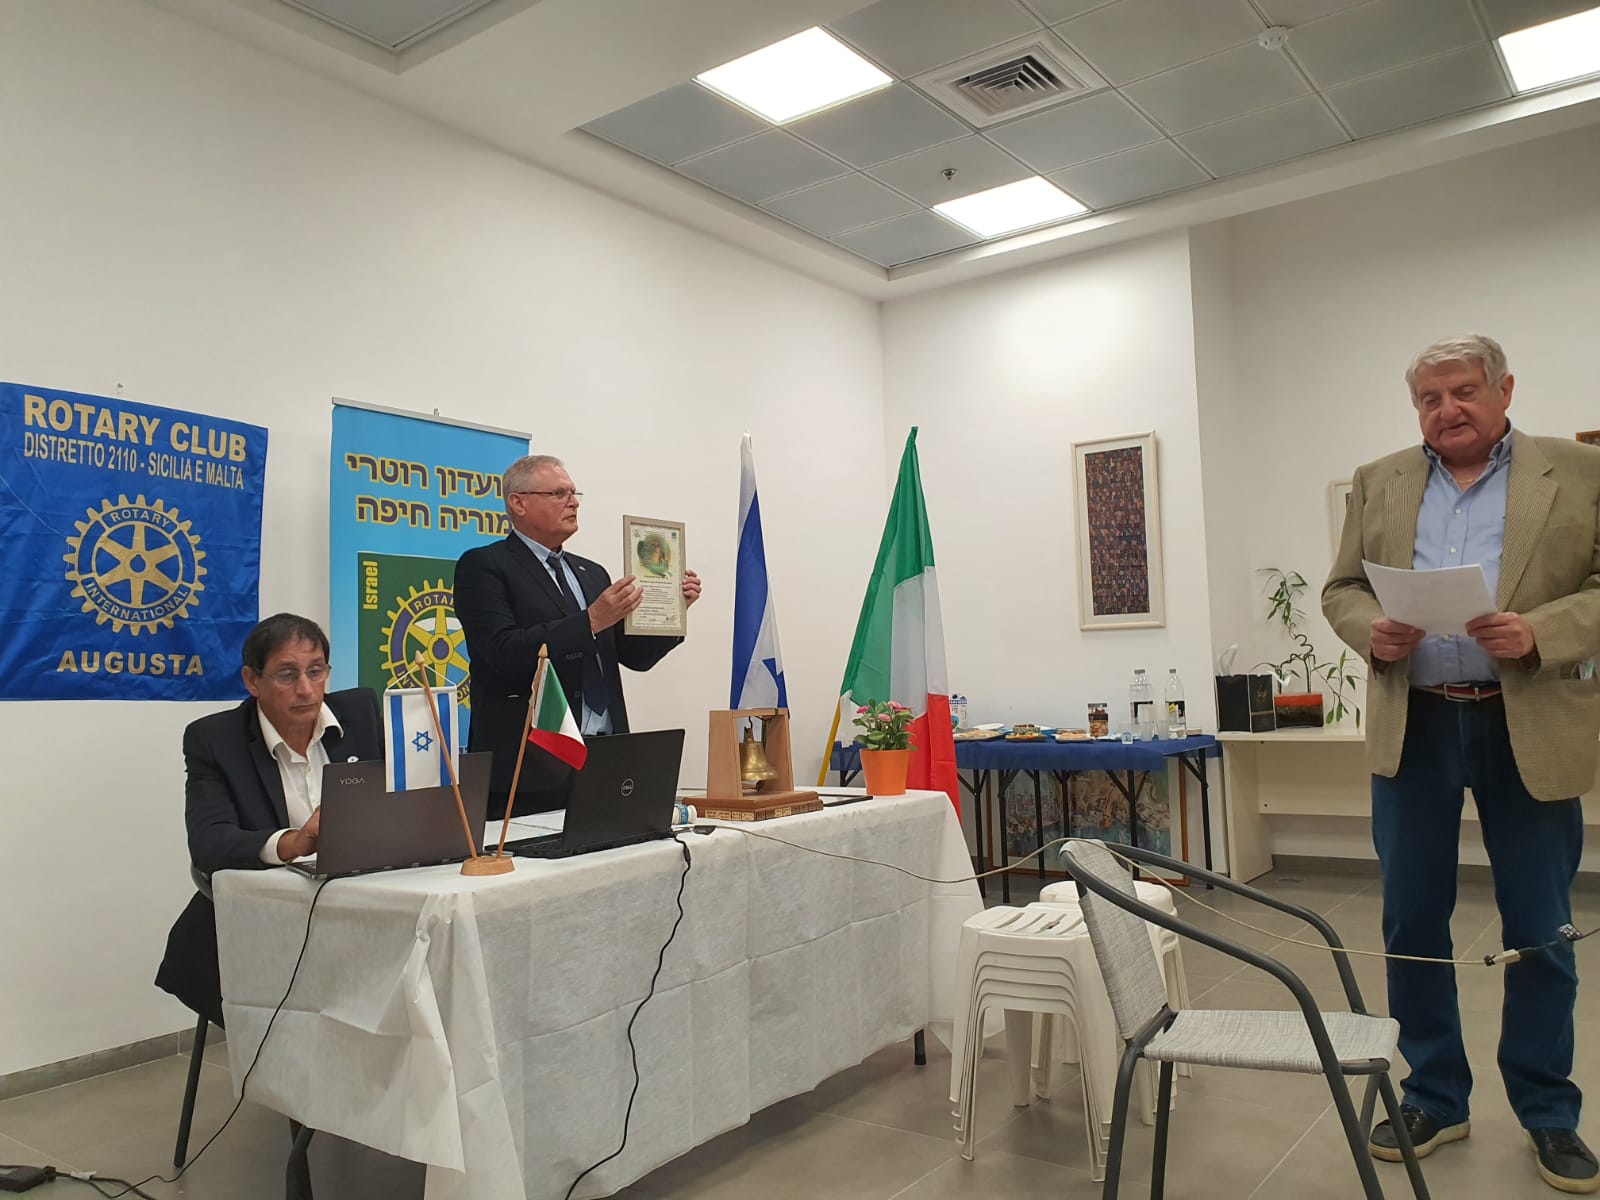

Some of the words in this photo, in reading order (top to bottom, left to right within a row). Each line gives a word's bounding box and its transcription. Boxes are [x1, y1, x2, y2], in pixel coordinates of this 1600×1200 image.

[24, 394, 161, 446] ROTARY
[170, 422, 247, 463] CLUB
[24, 431, 105, 468] DISTRETTO
[107, 445, 137, 473] 2110
[148, 451, 193, 482] SICILIA
[195, 459, 204, 484] E
[205, 461, 245, 490] MALTA
[345, 452, 429, 490] רוטרי
[434, 466, 504, 499] ועדון
[110, 508, 171, 528] ROTARY
[356, 495, 431, 528] חיפה
[439, 505, 513, 536] מוריה
[86, 581, 190, 622] INTERNATIONAL
[362, 560, 378, 610] Israel
[56, 650, 204, 677] AUGUSTA
[339, 776, 366, 785] YOGA
